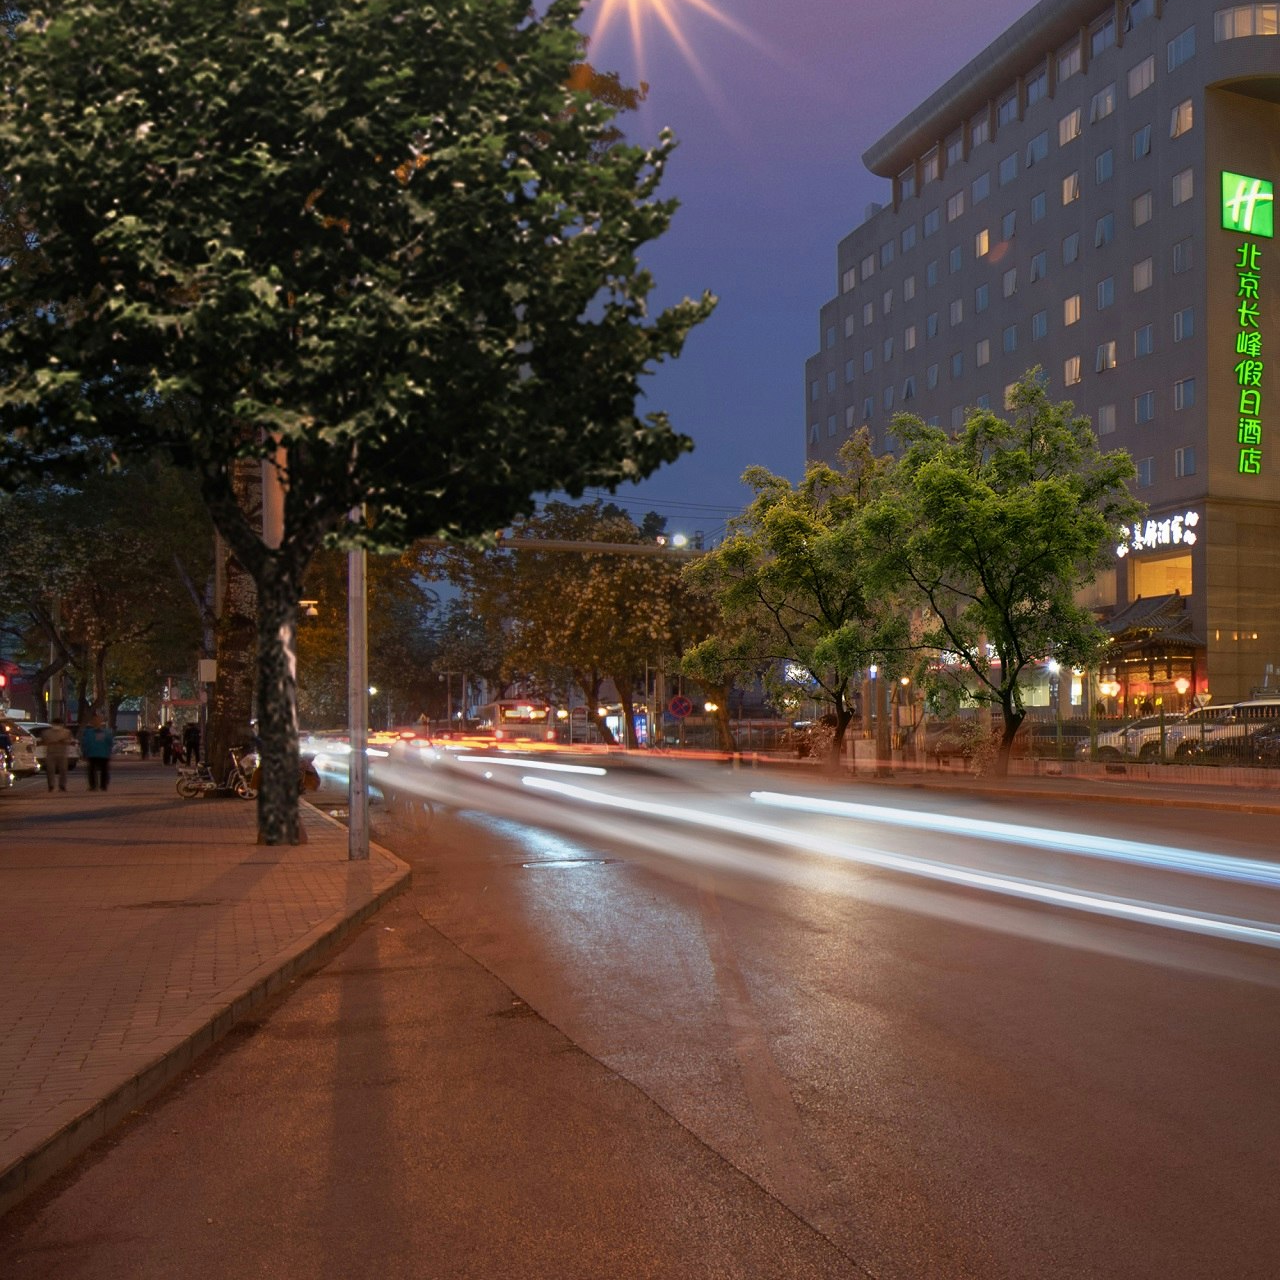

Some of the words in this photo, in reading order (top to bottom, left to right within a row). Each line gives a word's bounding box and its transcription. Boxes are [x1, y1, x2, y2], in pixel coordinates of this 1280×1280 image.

[1234, 242, 1264, 474] 北京长峰假日酒店
